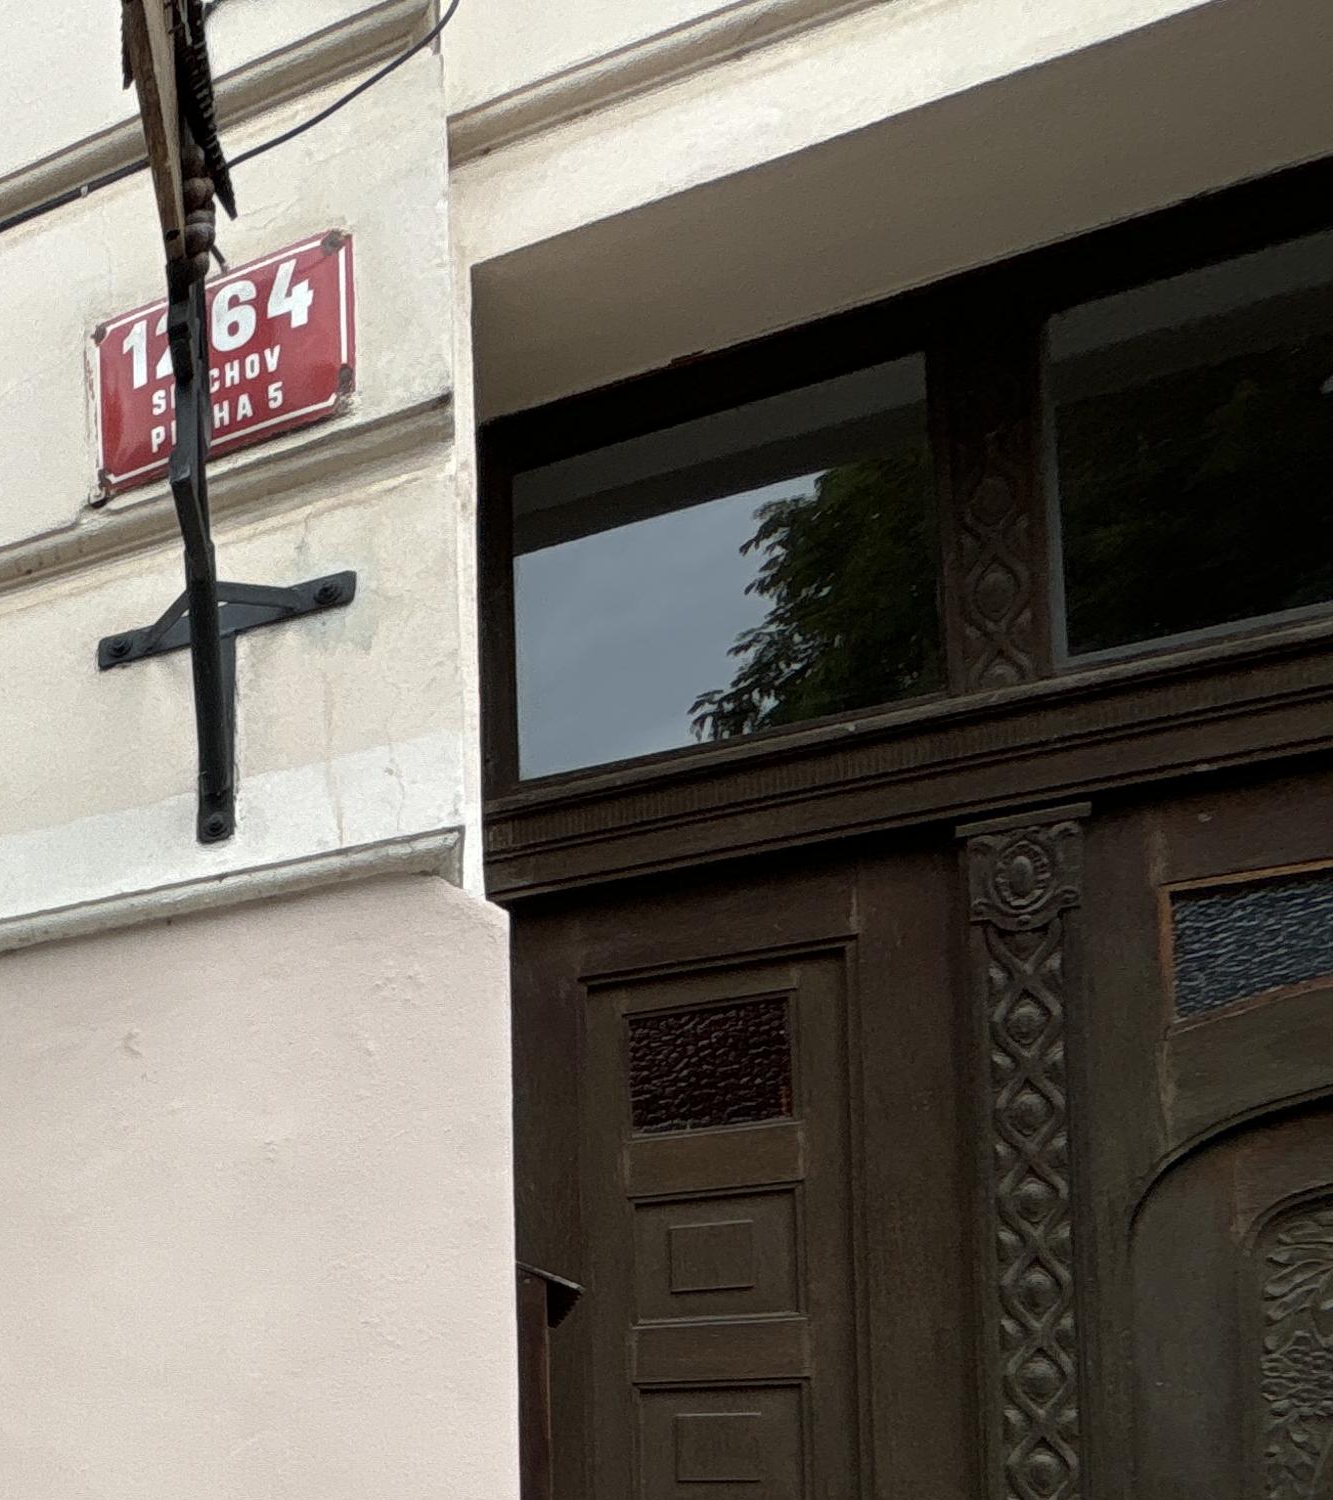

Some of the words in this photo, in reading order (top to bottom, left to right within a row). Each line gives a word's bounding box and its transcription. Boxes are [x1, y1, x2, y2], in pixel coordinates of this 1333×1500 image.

[152, 345, 282, 416] SCHOV
[151, 393, 254, 453] PHA
[267, 381, 284, 409] 5
